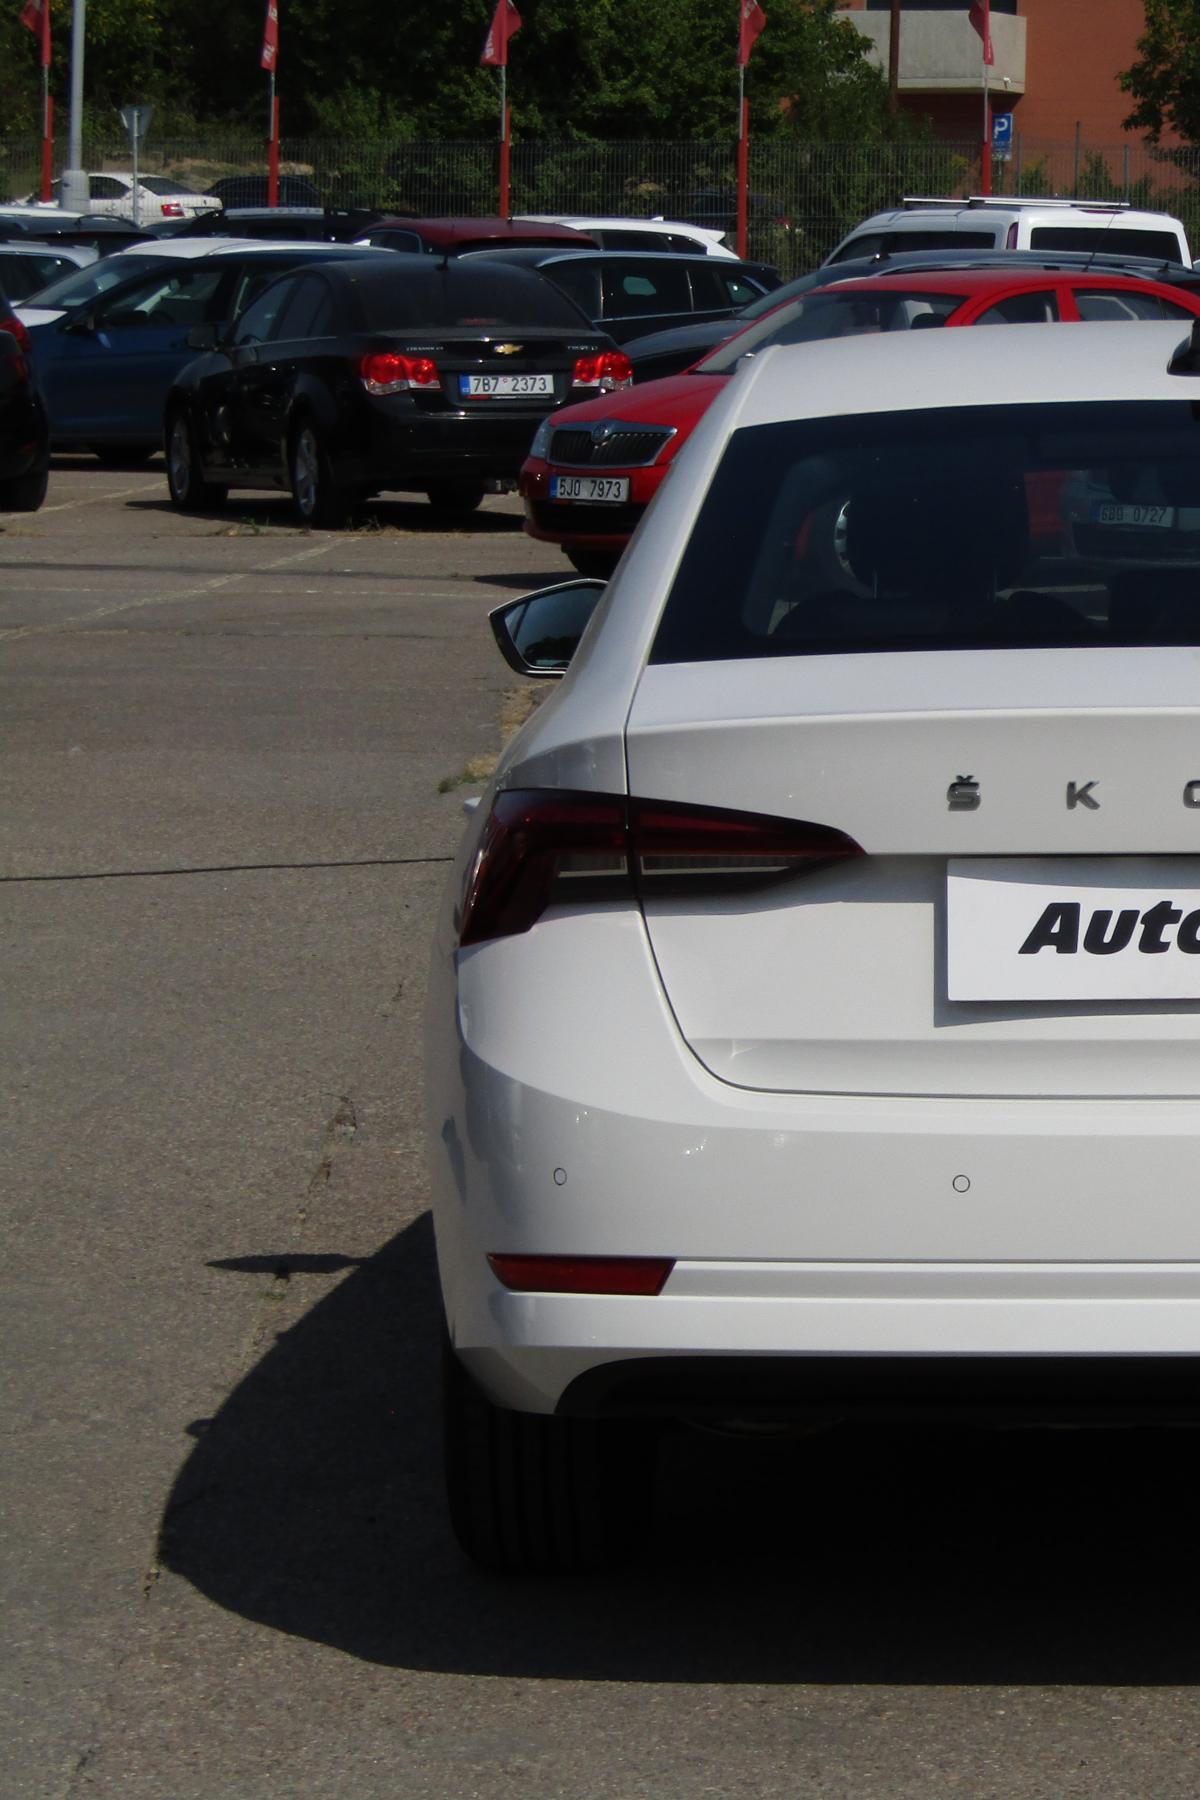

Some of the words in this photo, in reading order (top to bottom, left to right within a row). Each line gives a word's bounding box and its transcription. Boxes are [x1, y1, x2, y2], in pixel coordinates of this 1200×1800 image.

[473, 377, 499, 392] 7B7
[511, 376, 548, 392] 2373
[590, 480, 621, 498] 7973
